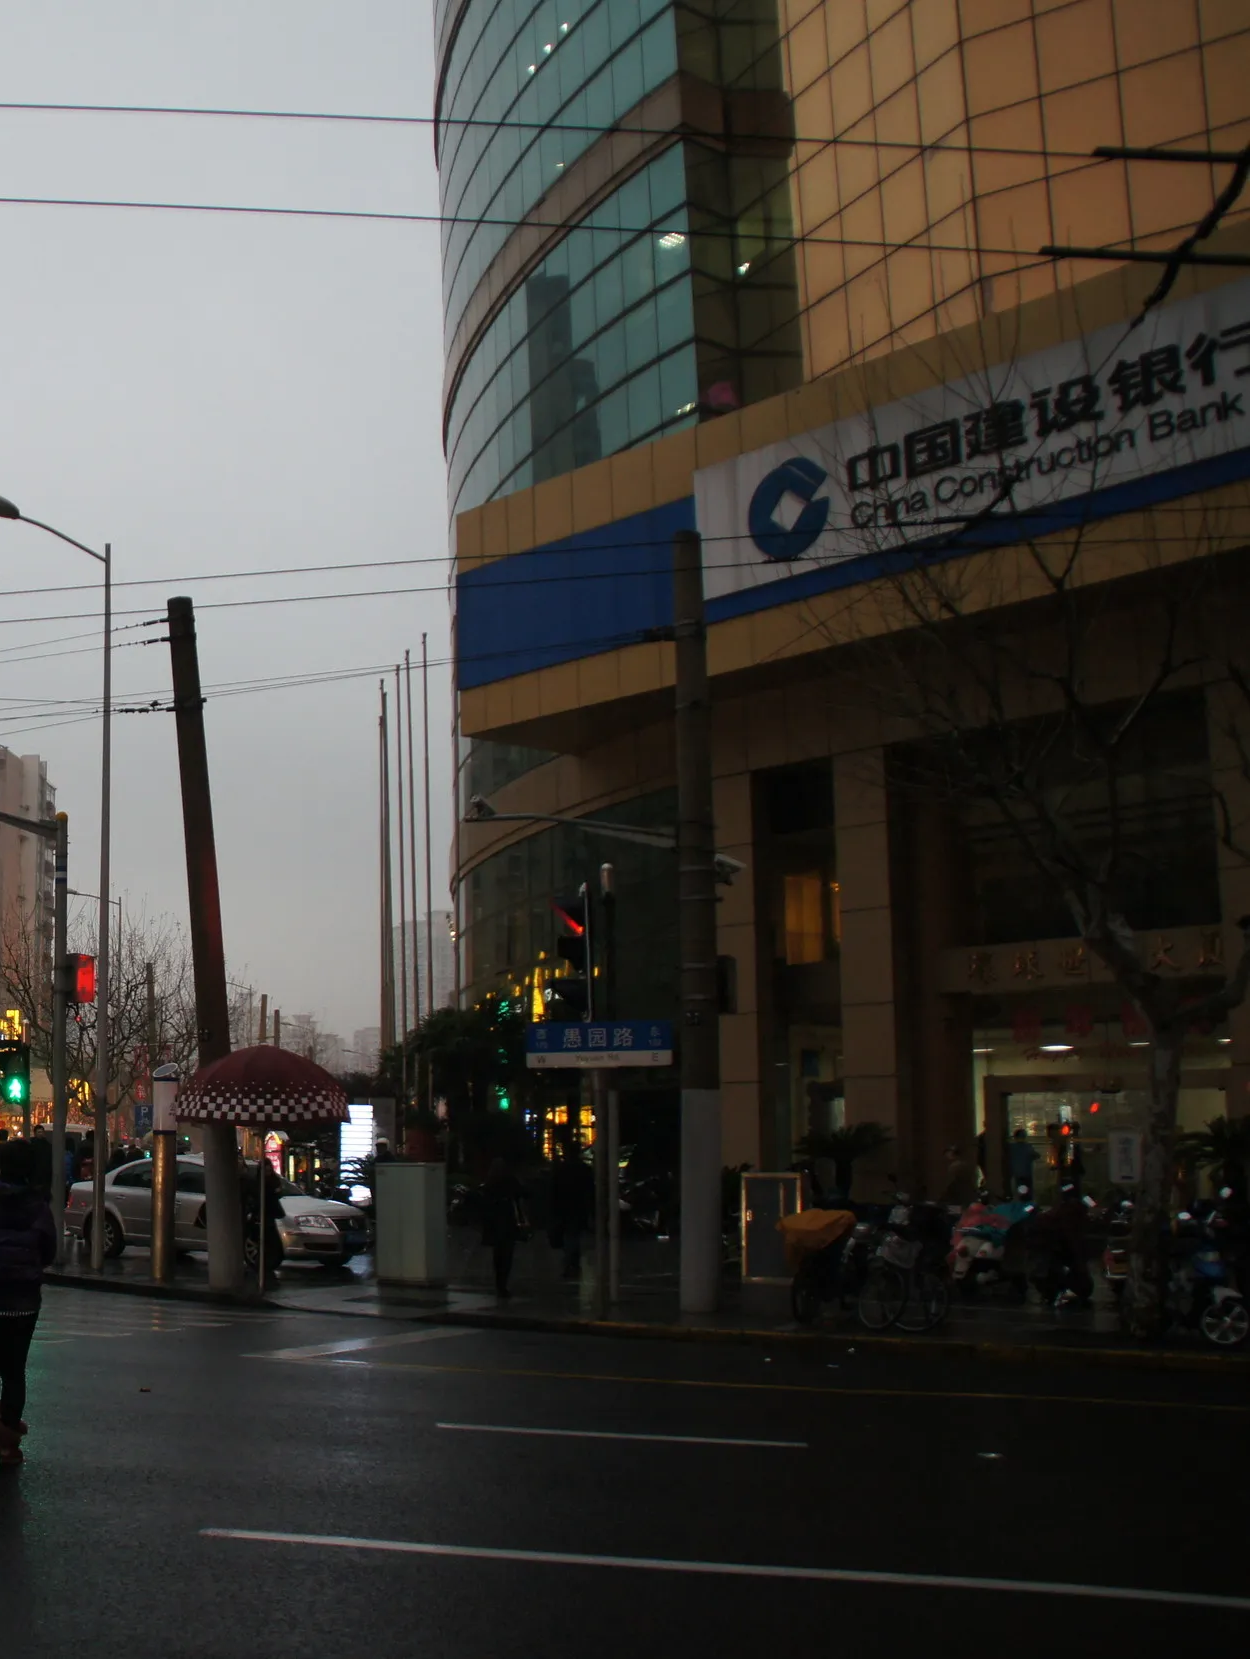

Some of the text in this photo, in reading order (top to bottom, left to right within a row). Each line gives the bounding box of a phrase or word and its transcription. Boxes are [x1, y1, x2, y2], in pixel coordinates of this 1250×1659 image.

[846, 321, 1250, 492] 中国建设银行
[935, 427, 1136, 504] Contruction
[1148, 391, 1246, 442] Bank
[562, 1027, 634, 1049] 愚园路
